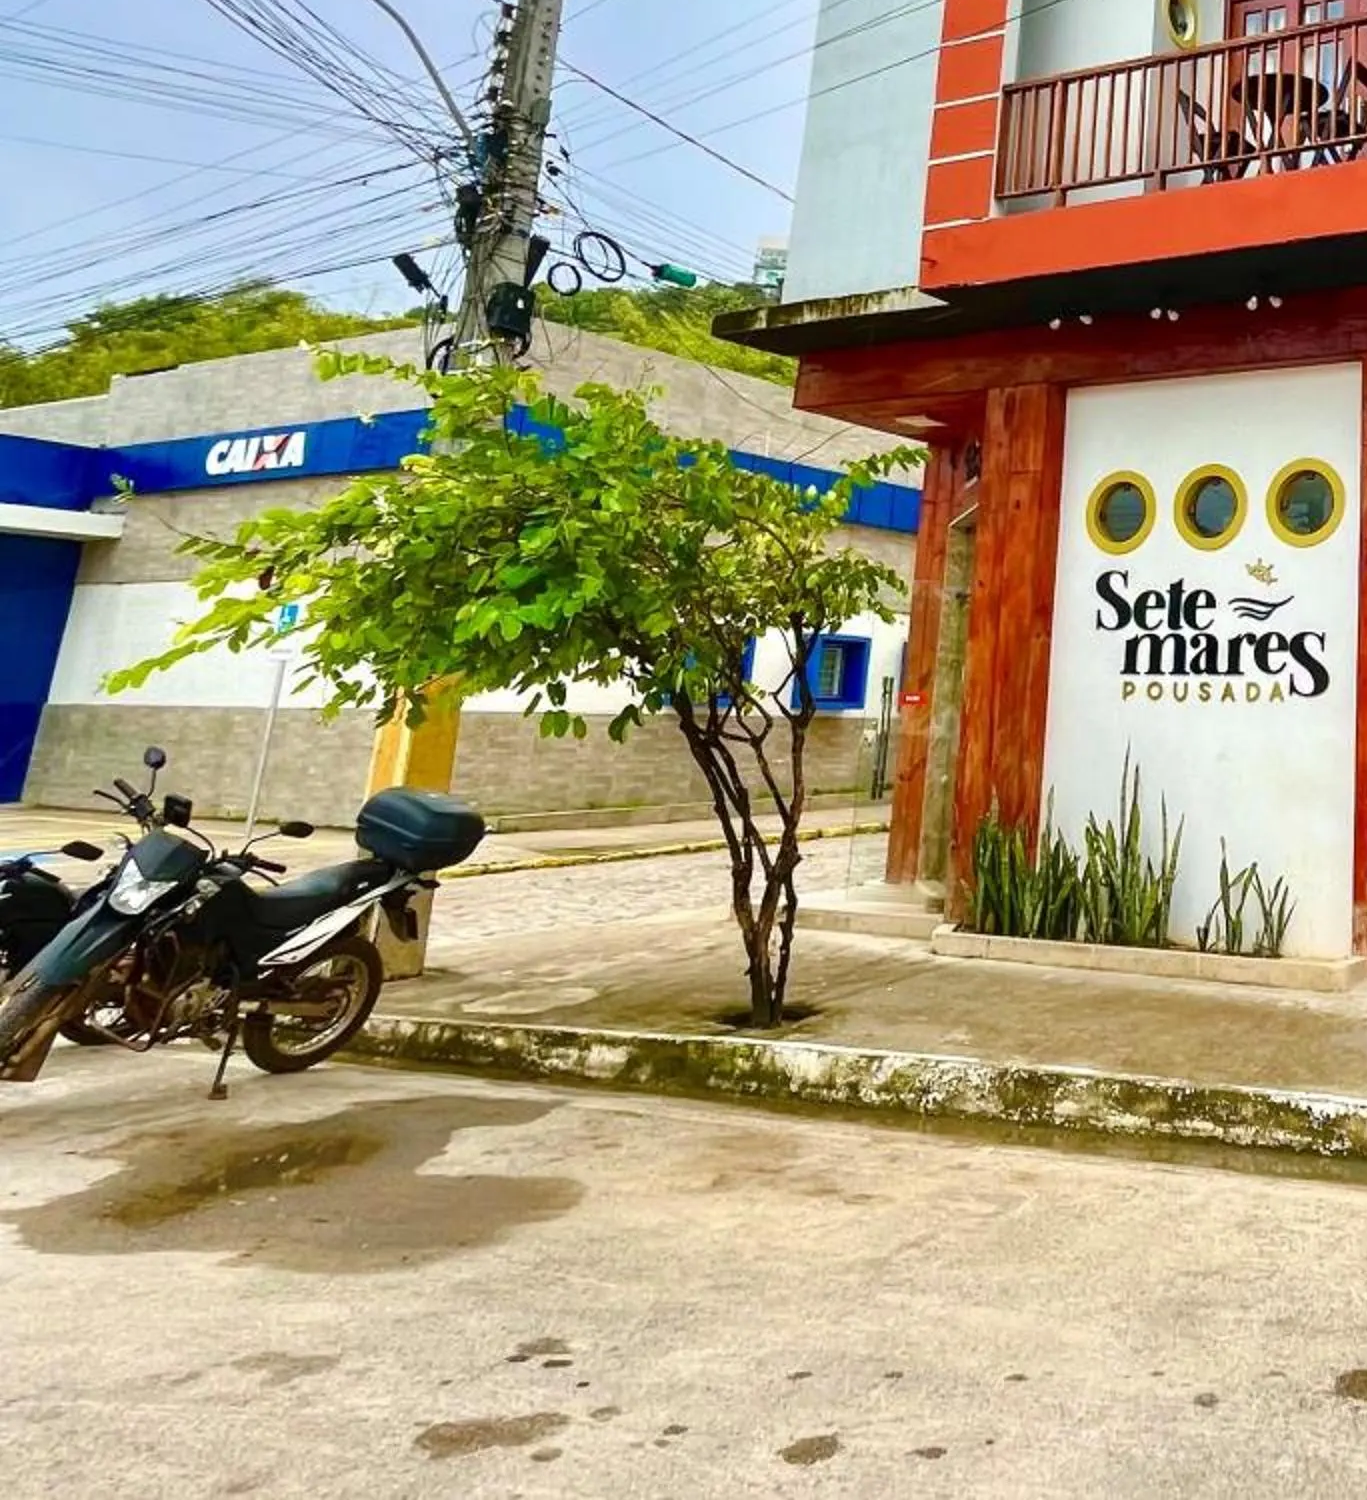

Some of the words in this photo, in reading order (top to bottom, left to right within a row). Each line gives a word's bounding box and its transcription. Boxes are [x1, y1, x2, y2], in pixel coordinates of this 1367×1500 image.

[205, 431, 306, 475] CAIXA
[1096, 570, 1217, 631] Sete
[1122, 681, 1285, 702] POUSADA
